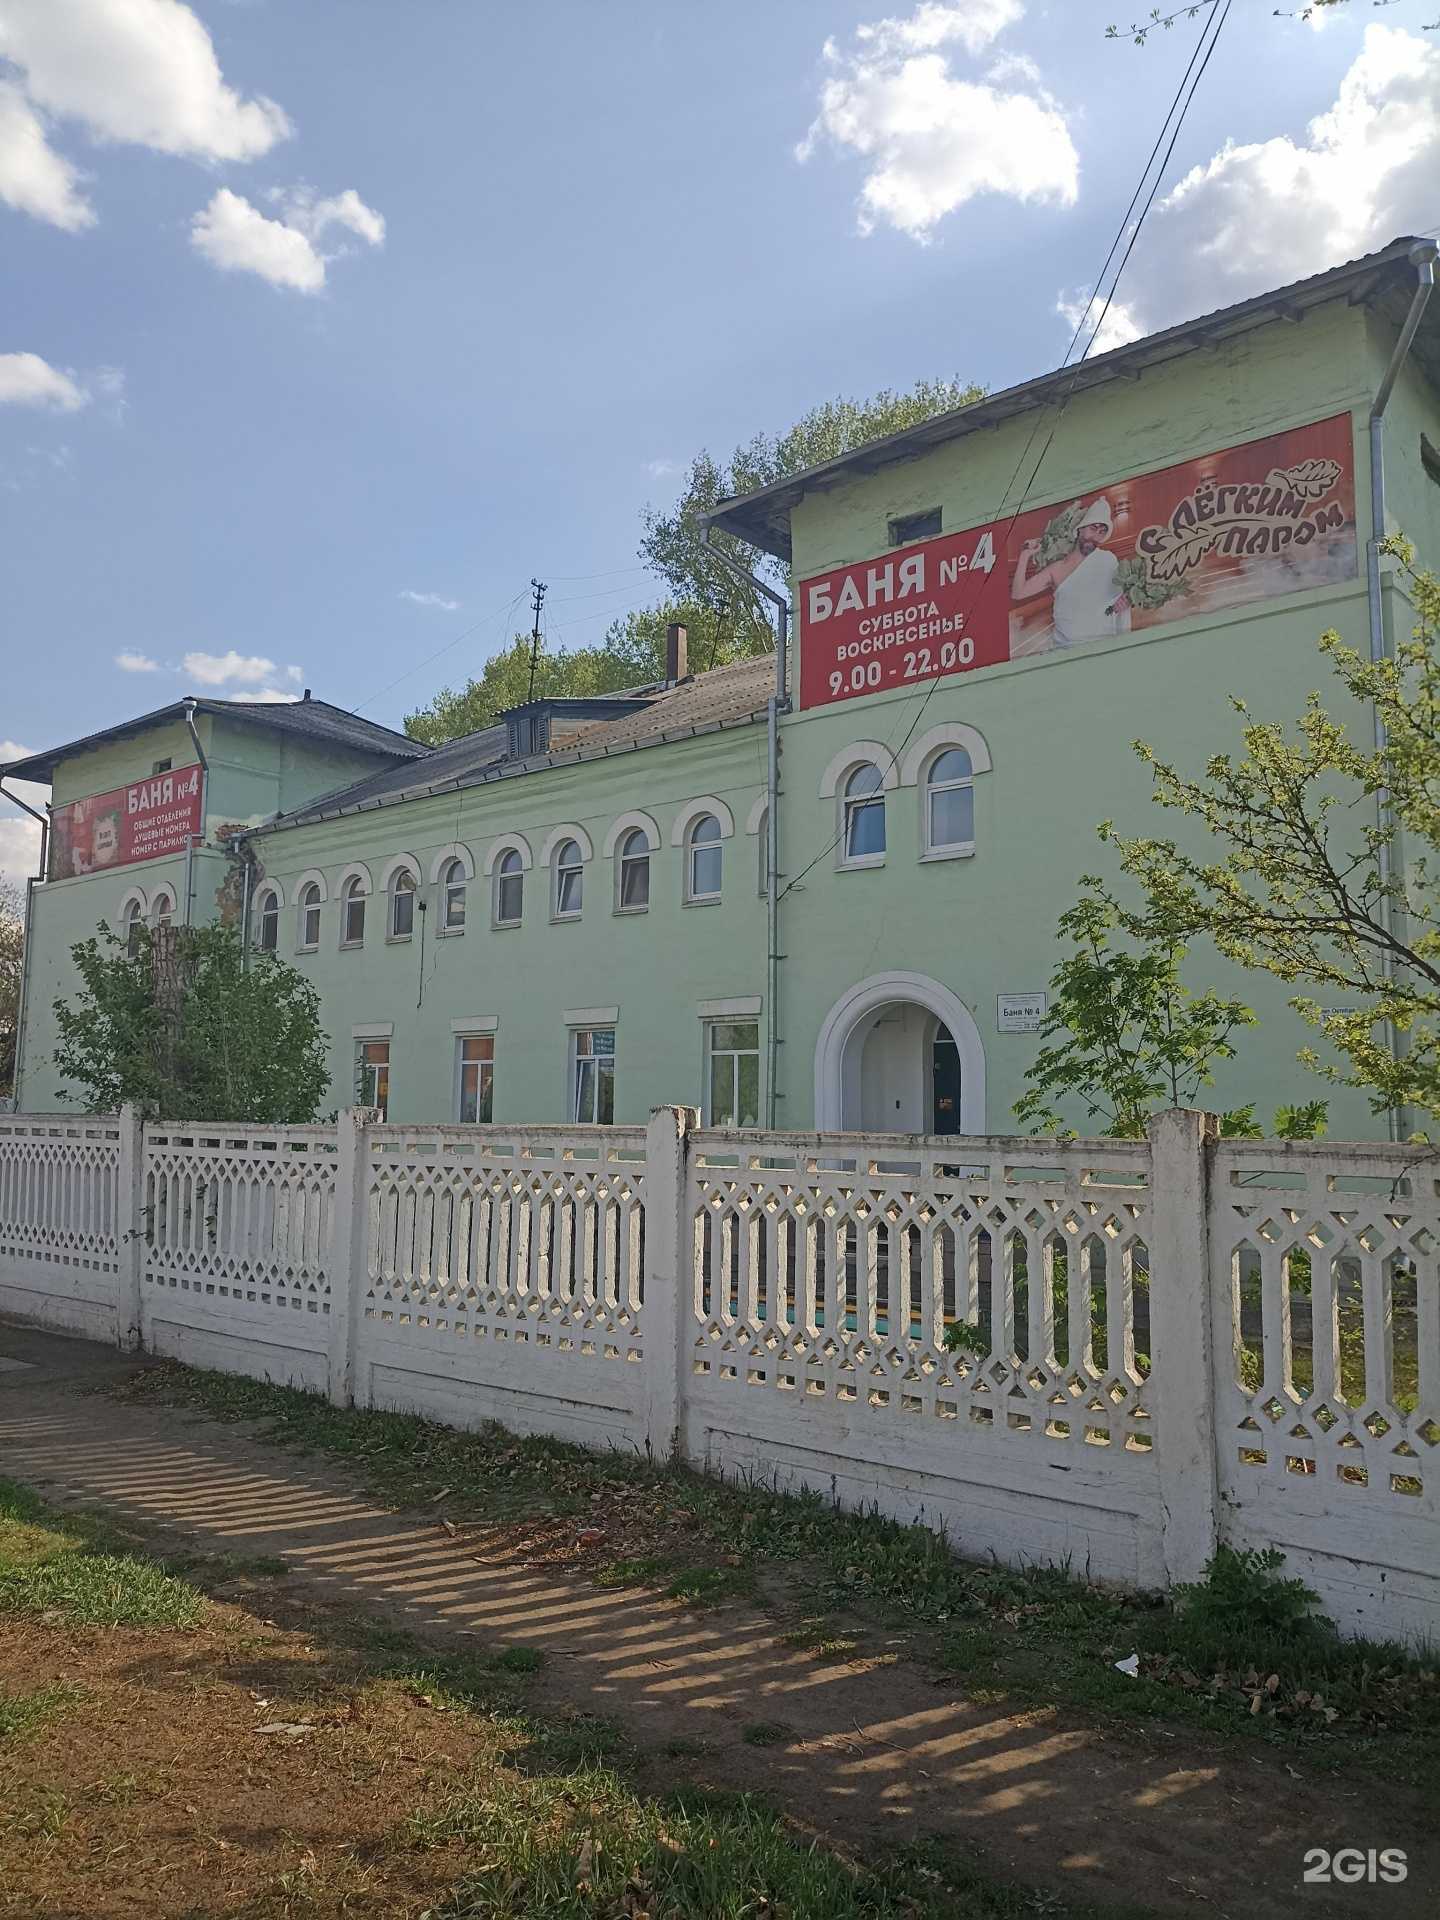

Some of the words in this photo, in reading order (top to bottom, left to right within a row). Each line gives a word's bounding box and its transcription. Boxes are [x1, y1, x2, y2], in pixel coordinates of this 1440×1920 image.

[1140, 528, 1167, 553] С
[1172, 485, 1306, 539] ЛЁГКИМ
[1224, 504, 1344, 554] ПАРОМ
[808, 553, 925, 624] БАНЯ
[837, 613, 964, 661] ВОСКРЕСЕНЬЕ
[858, 601, 940, 635] СУББОТА
[829, 661, 882, 696] 9.00
[903, 638, 974, 678] 22.00
[128, 778, 173, 815] БАНЯ
[131, 844, 152, 856] НОМЕР
[152, 842, 158, 851] С
[134, 827, 164, 843] ДУШЕВЫЕ
[165, 821, 190, 835] НОМЕРА
[1003, 1008, 1022, 1017] Баня
